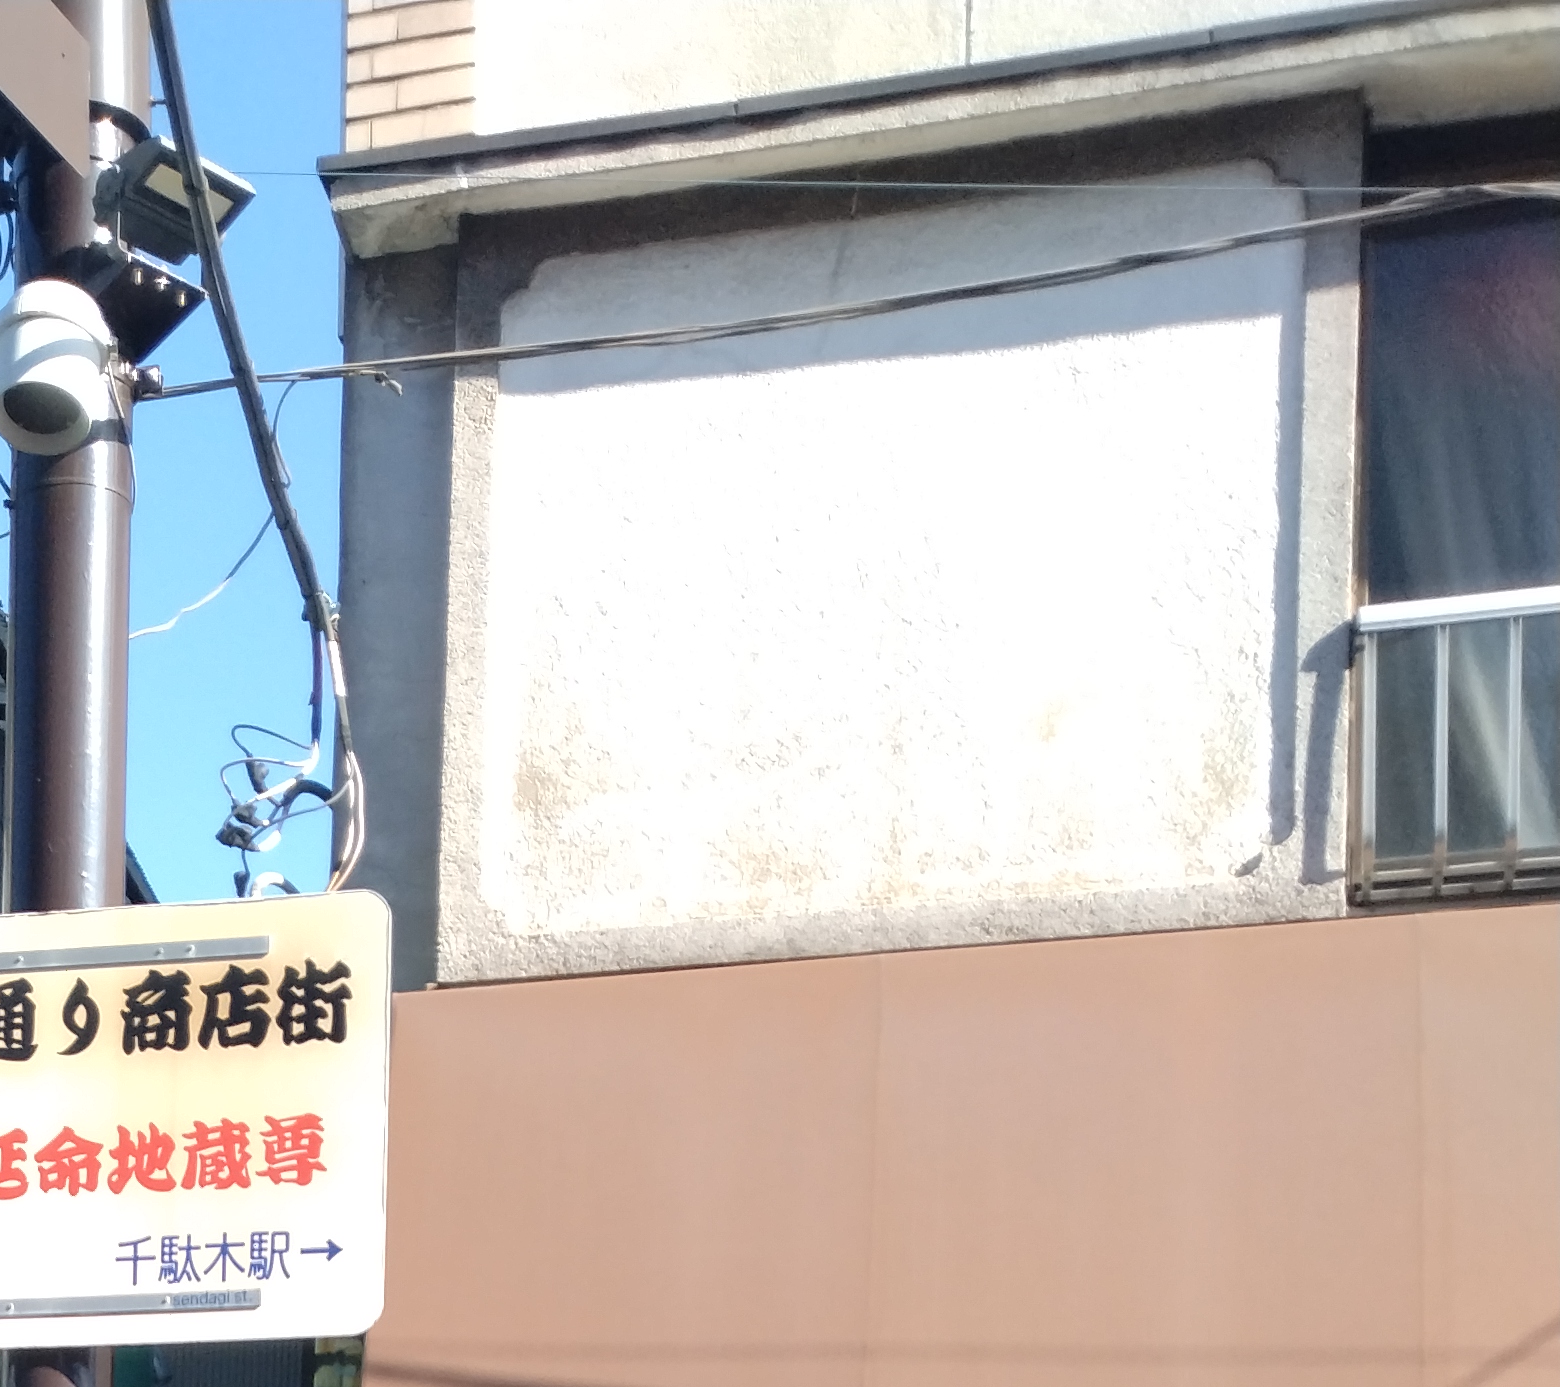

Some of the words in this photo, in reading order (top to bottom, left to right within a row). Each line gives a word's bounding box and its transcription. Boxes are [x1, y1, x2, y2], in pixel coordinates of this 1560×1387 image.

[114, 1231, 291, 1287] 千駄木駅
[172, 1289, 230, 1306] sendagi
